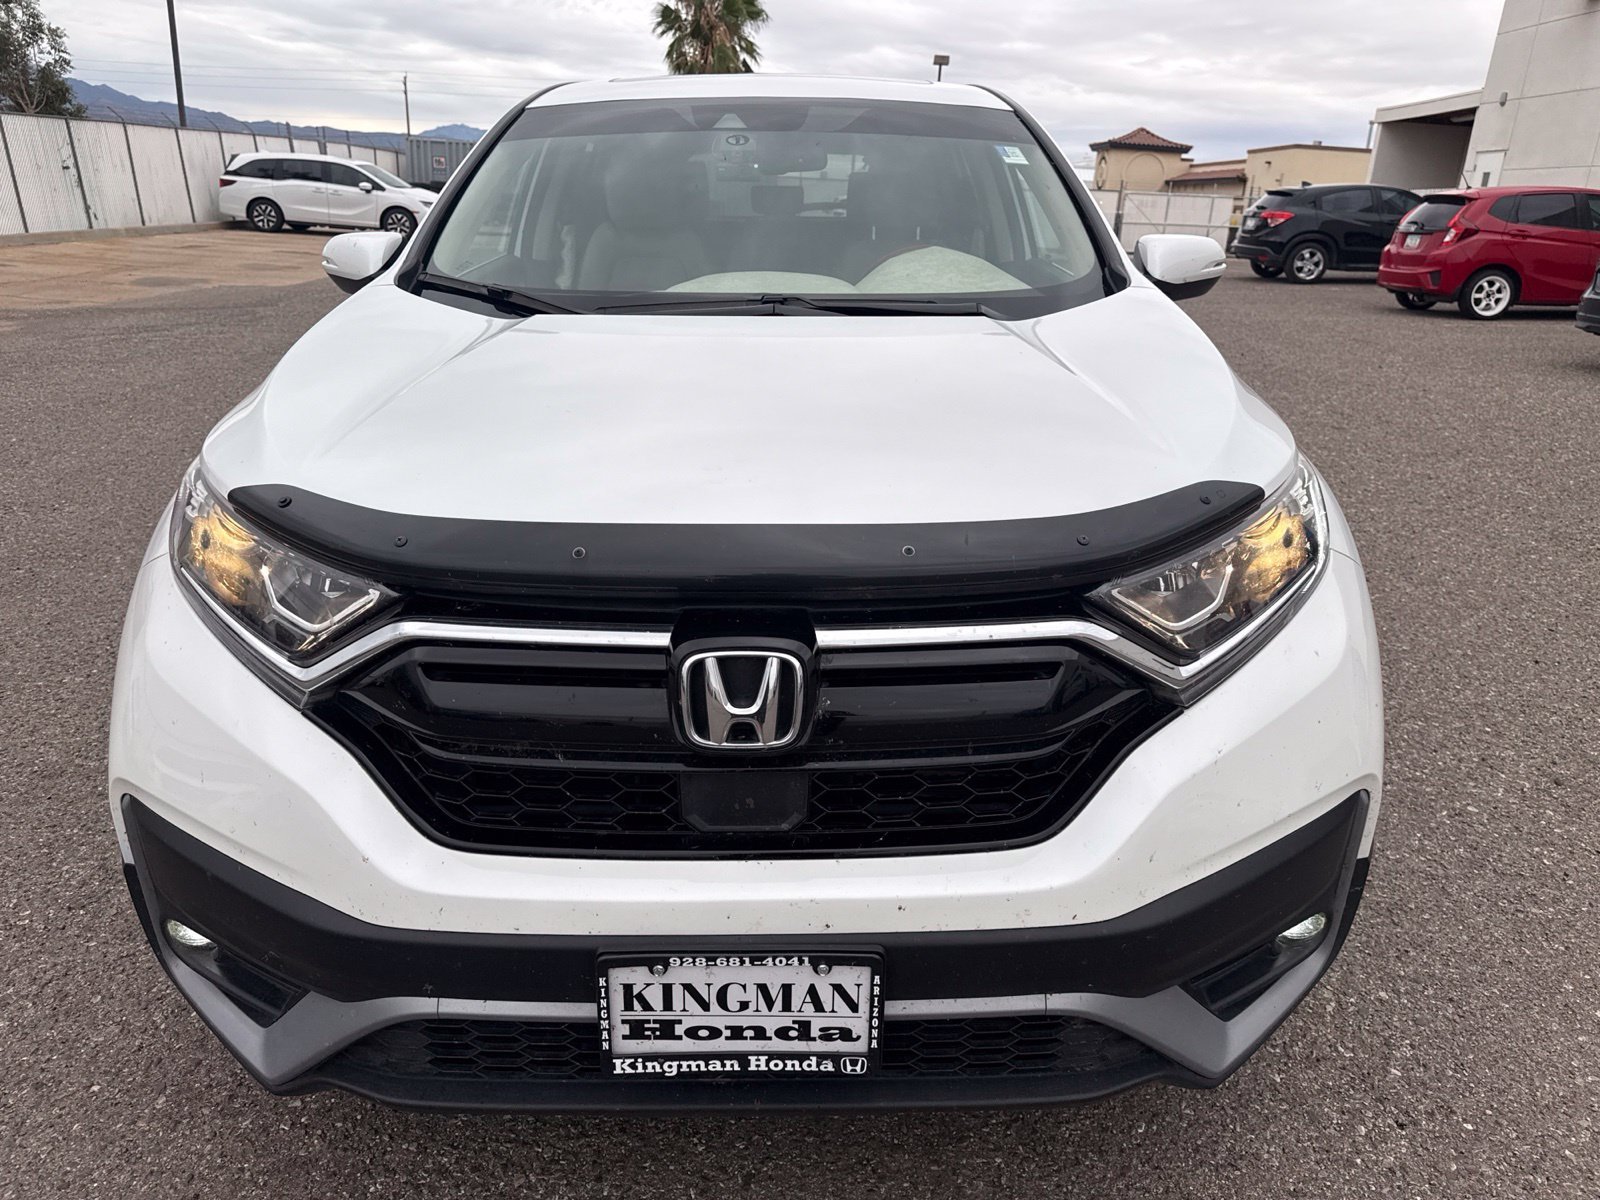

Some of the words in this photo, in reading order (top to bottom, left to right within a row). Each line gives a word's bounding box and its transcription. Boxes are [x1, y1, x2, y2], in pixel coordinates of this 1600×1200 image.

[669, 957, 811, 967] 928-681-4041
[619, 983, 863, 1013] KINGMAN
[598, 977, 610, 1050] KINGMAN
[871, 976, 881, 1049] ARIZONA
[621, 1019, 862, 1042] Honda
[613, 1057, 740, 1076] Kingman
[747, 1056, 835, 1072] Honda
